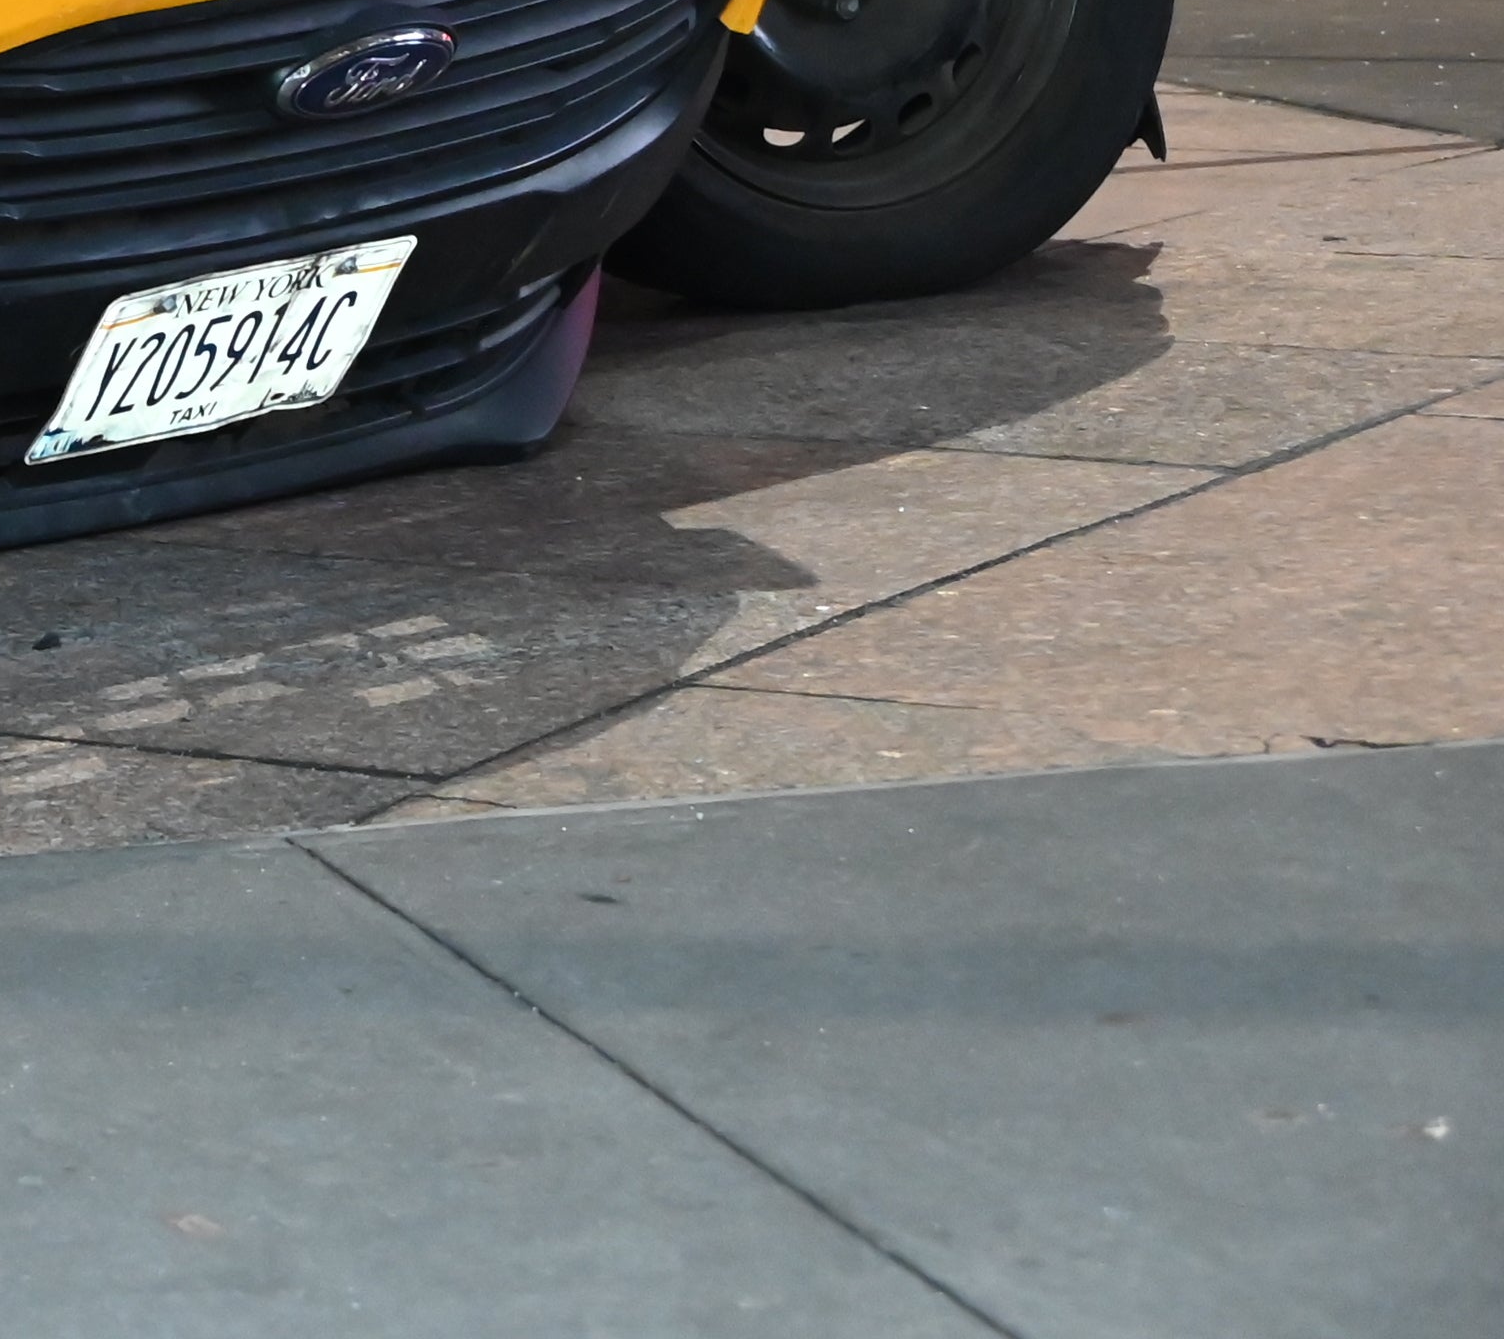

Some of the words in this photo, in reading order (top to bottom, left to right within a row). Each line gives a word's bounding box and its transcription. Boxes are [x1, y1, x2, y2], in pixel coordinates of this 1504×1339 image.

[324, 52, 428, 108] Ford
[172, 279, 252, 319] NEW
[251, 263, 329, 304] YORK
[85, 289, 358, 423] Y205914C
[168, 401, 219, 426] TAXI
